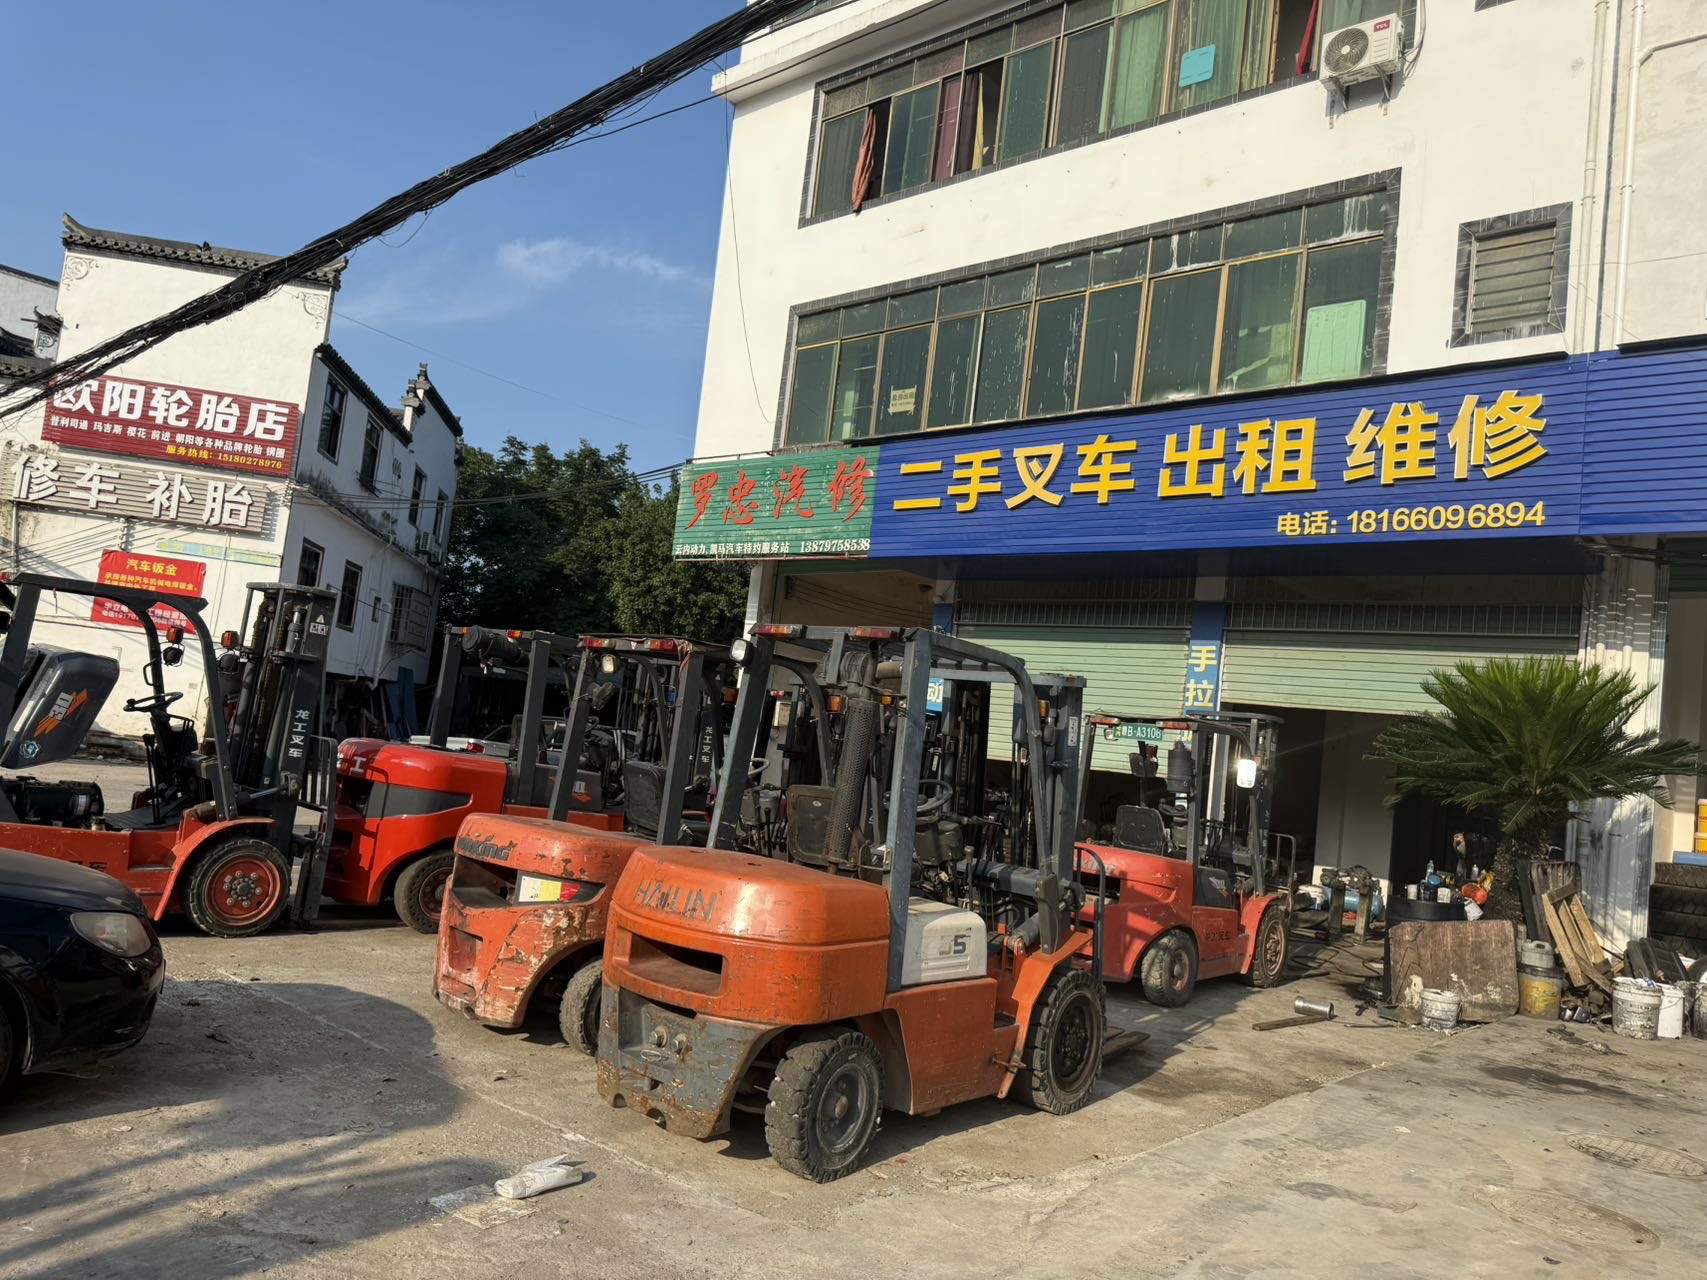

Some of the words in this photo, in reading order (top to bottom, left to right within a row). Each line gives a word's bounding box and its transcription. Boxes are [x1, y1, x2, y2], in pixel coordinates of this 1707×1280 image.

[53, 379, 289, 441] 欧阳轮胎店
[892, 434, 1137, 512] 二手叉车
[1157, 416, 1317, 497] 出租
[1343, 390, 1548, 485] 维修
[11, 453, 120, 509] 修车
[147, 472, 253, 528] 补胎
[1347, 500, 1546, 534] 18166096894
[126, 558, 177, 576] 汽车钣金
[800, 538, 871, 553] 13879758538
[289, 709, 310, 757] 龙工叉车
